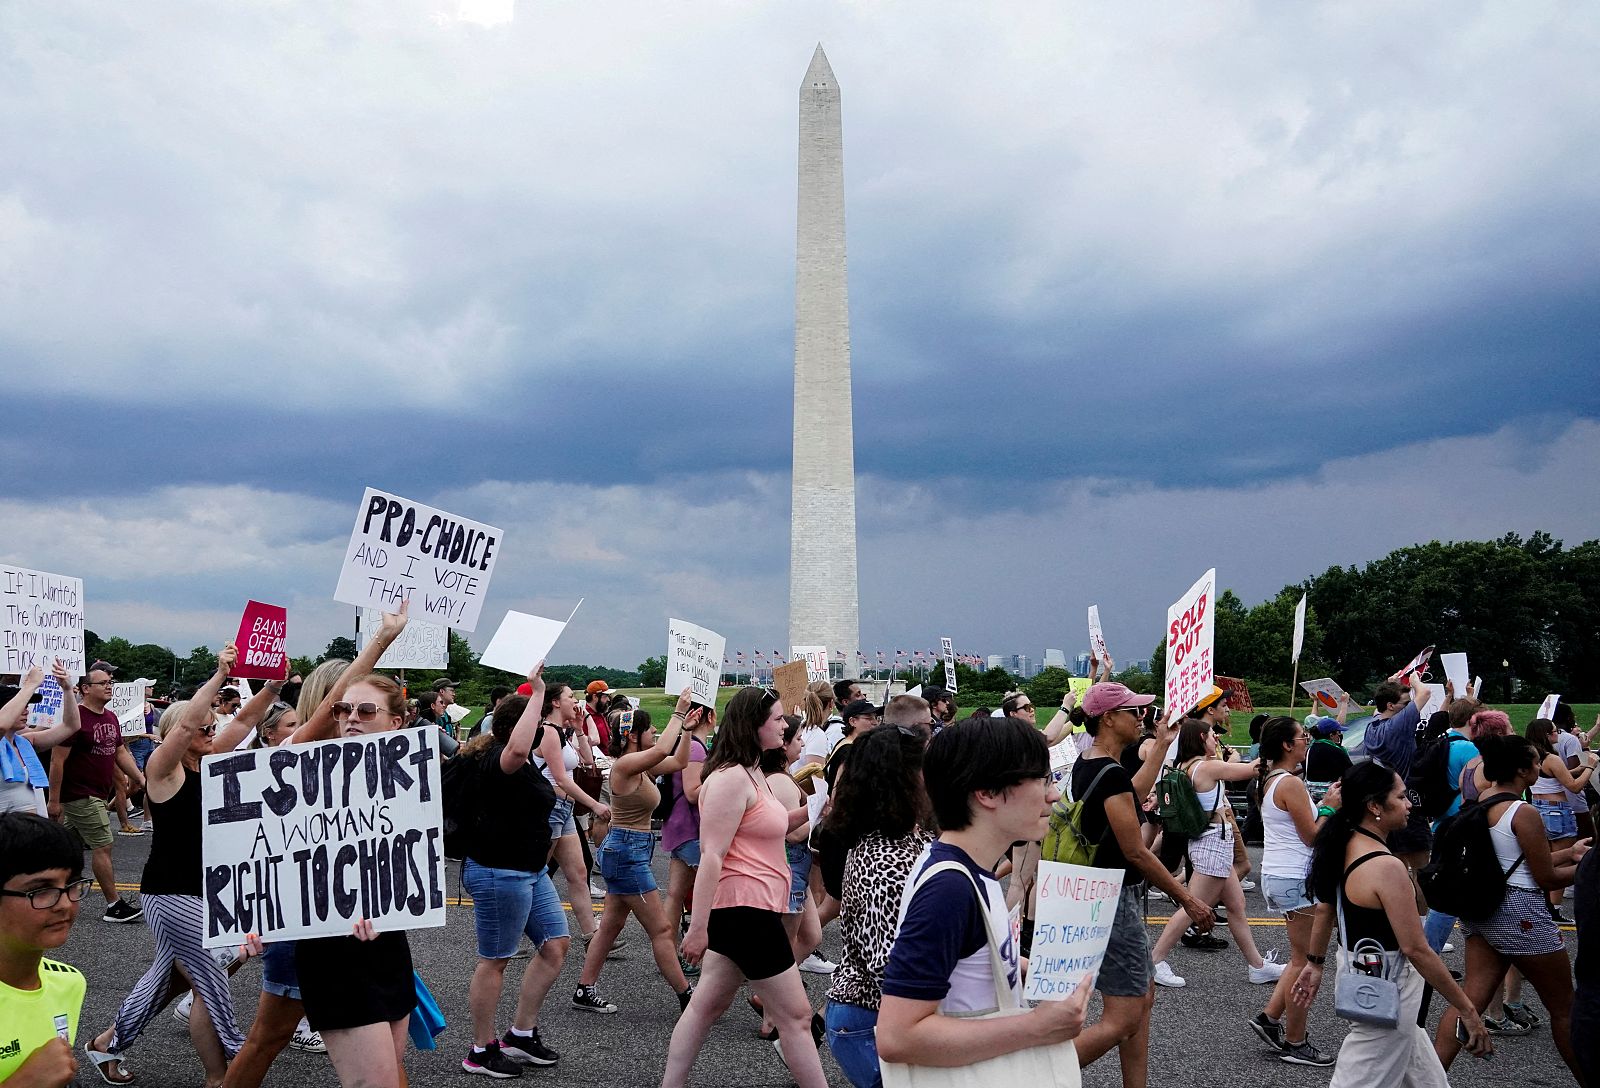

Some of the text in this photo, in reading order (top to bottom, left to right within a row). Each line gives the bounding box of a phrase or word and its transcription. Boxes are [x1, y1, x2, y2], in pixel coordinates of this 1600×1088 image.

[363, 495, 496, 571] PRO-CHOICE
[352, 542, 479, 596] AND I VOTE
[4, 571, 77, 607] If I Wanted
[368, 576, 417, 604] THAT
[6, 603, 29, 626] The
[252, 616, 285, 637] BANS
[1169, 594, 1207, 648] SOLD
[4, 630, 18, 648] In
[22, 631, 38, 650] my
[248, 632, 274, 651] OFF
[1174, 623, 1203, 666] OUT
[245, 649, 284, 668] BODIES
[208, 753, 263, 825] I
[250, 800, 394, 859] A WOMAN'S
[205, 826, 443, 938] RIGHT TO CHOOSE
[1040, 872, 1052, 899] 6
[1061, 925, 1089, 944] YEARS
